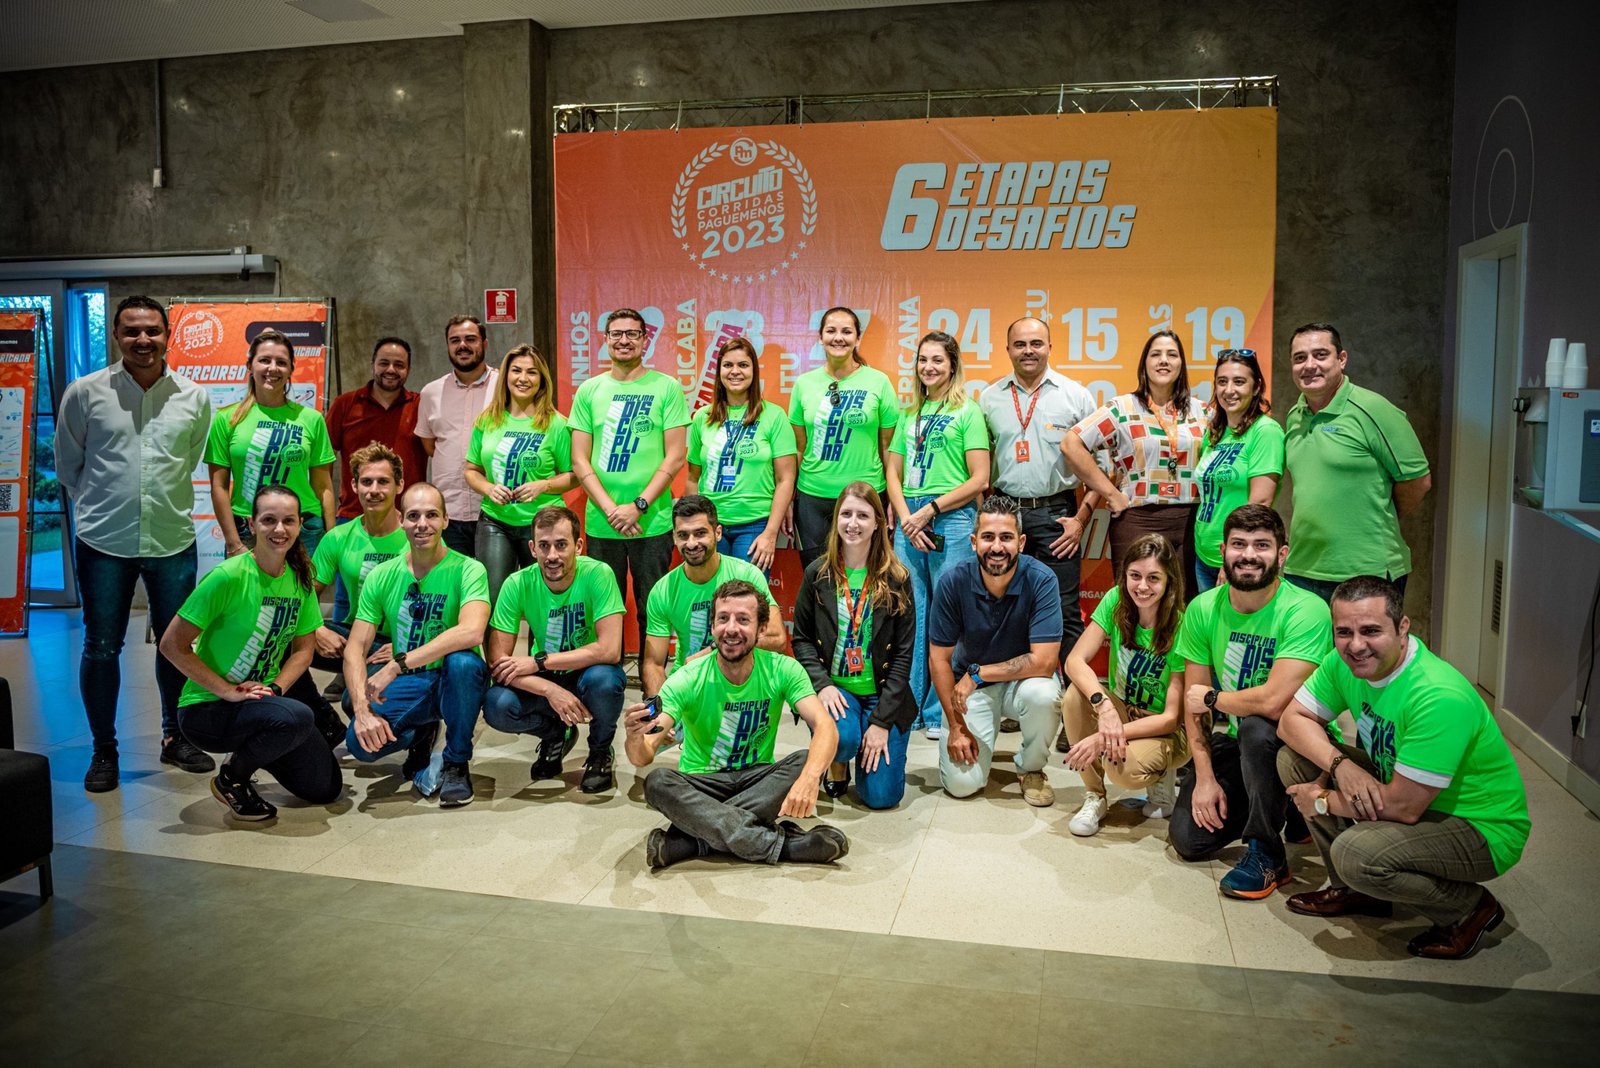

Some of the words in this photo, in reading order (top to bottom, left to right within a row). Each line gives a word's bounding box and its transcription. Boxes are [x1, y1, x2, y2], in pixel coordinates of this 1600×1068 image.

[697, 166, 783, 210] CIRCUITO
[697, 191, 784, 219] CORRIDAS
[698, 202, 784, 231] PAGUEMENOS
[880, 162, 947, 250] 6
[948, 160, 1111, 205] ETAPAS
[702, 214, 785, 259] 2023
[935, 205, 1138, 251] DESAFIOS
[184, 337, 213, 350] 2023
[1061, 308, 1118, 361] 15
[177, 365, 247, 380] PERCURSO
[621, 401, 653, 417] DIS
[257, 421, 304, 433] DISCIPLINA
[268, 428, 303, 446] DIS
